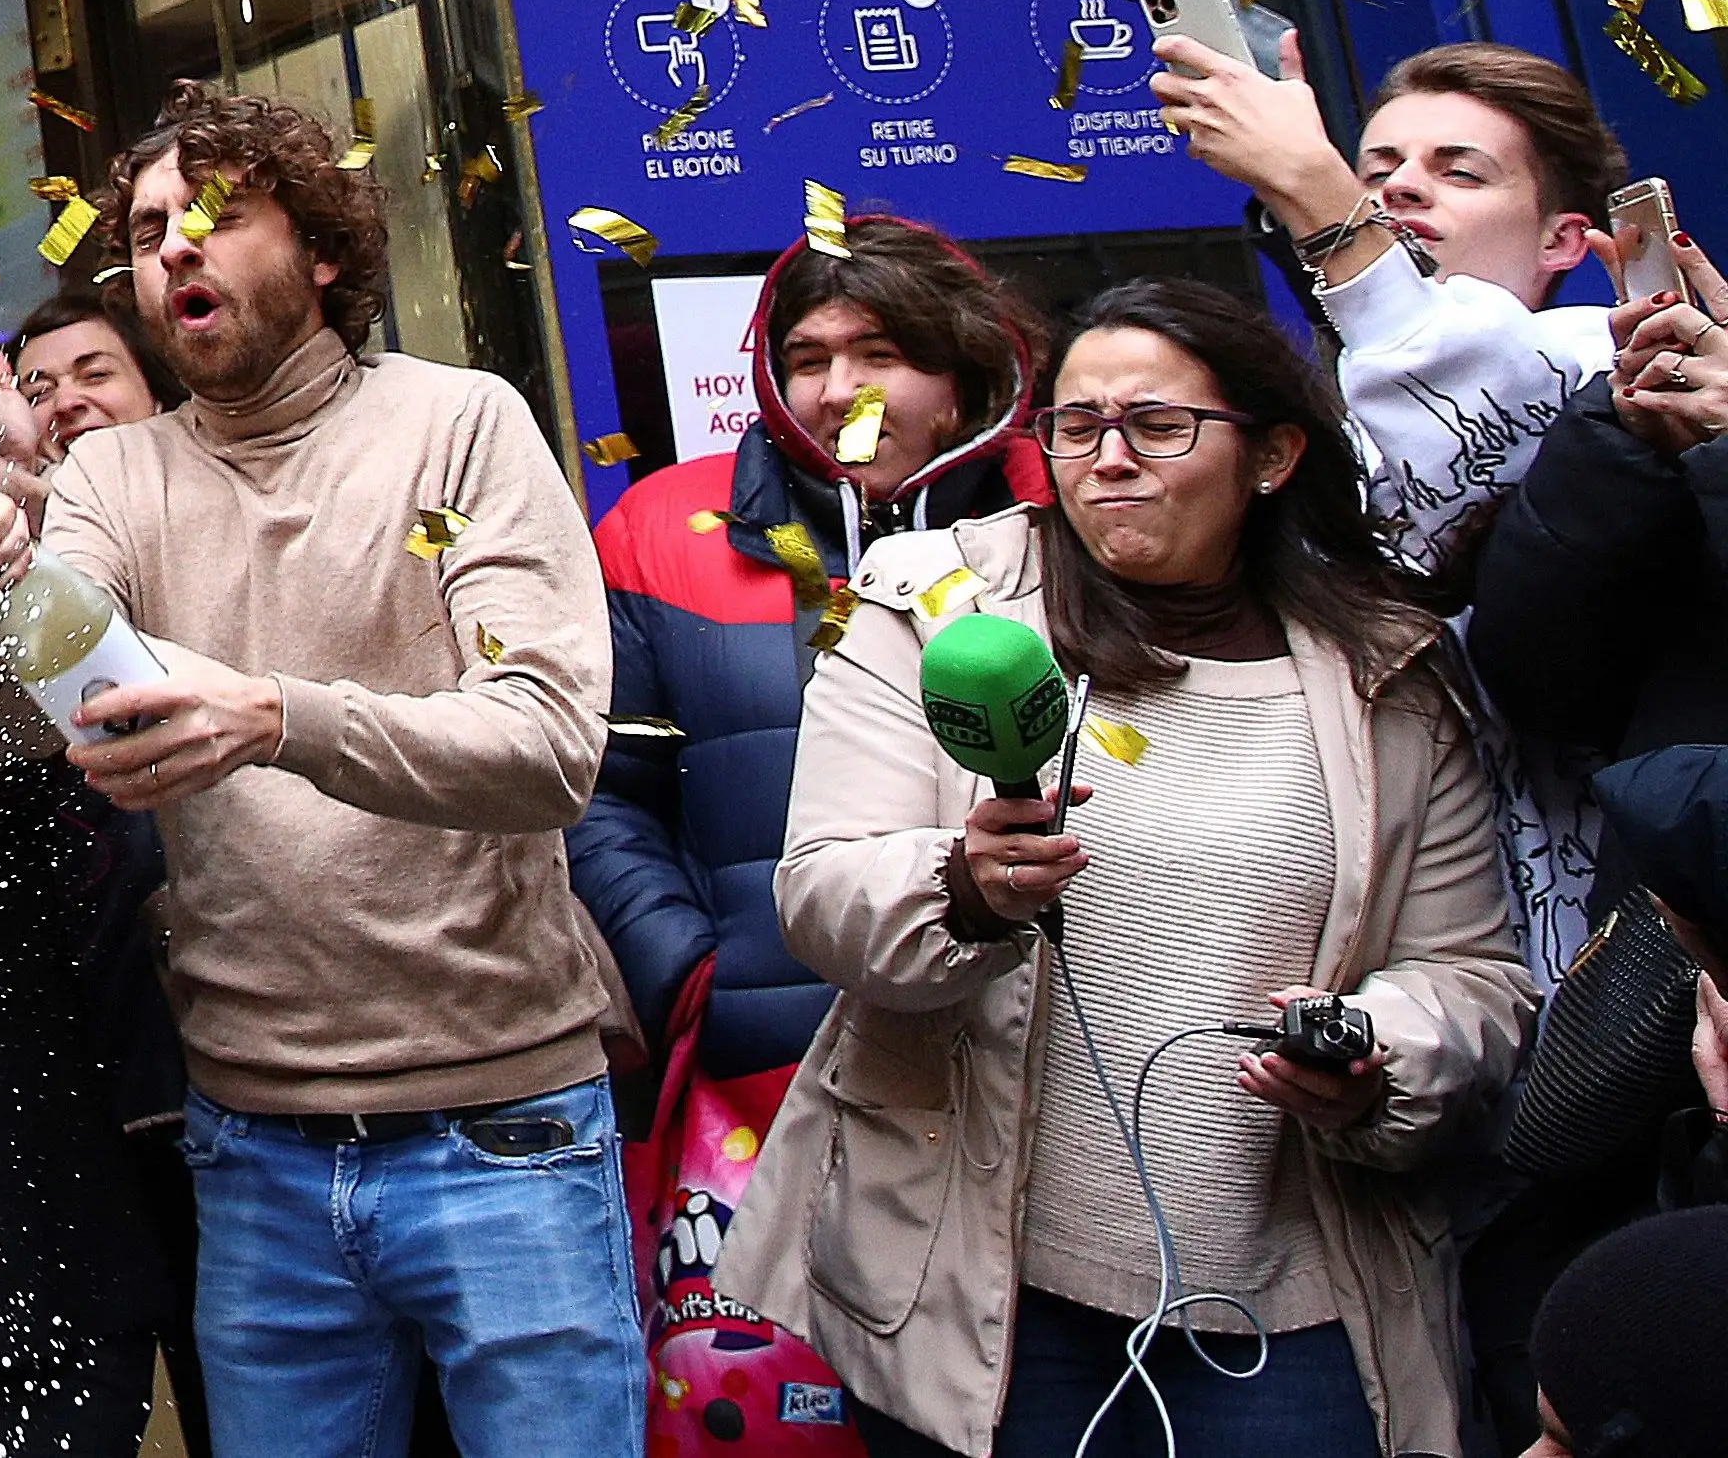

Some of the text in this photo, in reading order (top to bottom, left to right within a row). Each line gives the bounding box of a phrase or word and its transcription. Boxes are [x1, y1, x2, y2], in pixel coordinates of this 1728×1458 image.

[871, 118, 937, 142] RETIRE
[858, 142, 958, 169] SU TURNO
[1067, 137, 1095, 159] SU
[645, 151, 742, 181] EL BOTÓN
[693, 374, 746, 398] HOY
